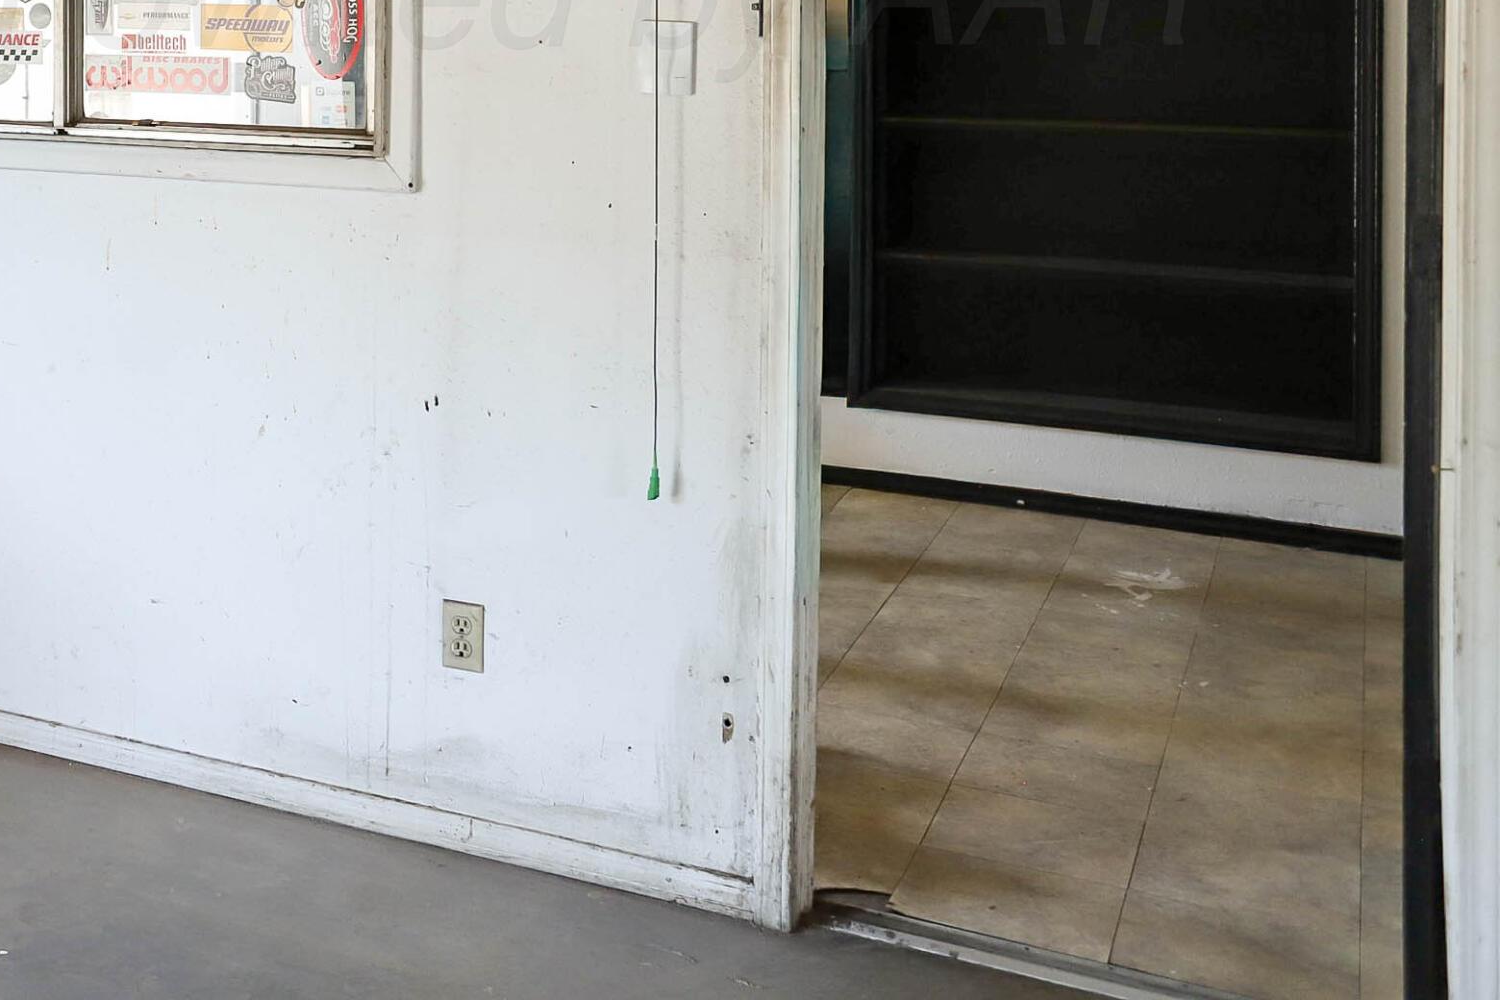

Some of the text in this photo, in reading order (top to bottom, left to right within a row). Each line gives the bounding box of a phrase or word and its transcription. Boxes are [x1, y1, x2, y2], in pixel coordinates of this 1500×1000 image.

[205, 18, 290, 34] SPEEDWAY
[343, 18, 358, 43] HOG
[138, 34, 186, 50] belltech
[173, 56, 222, 65] BRAKES
